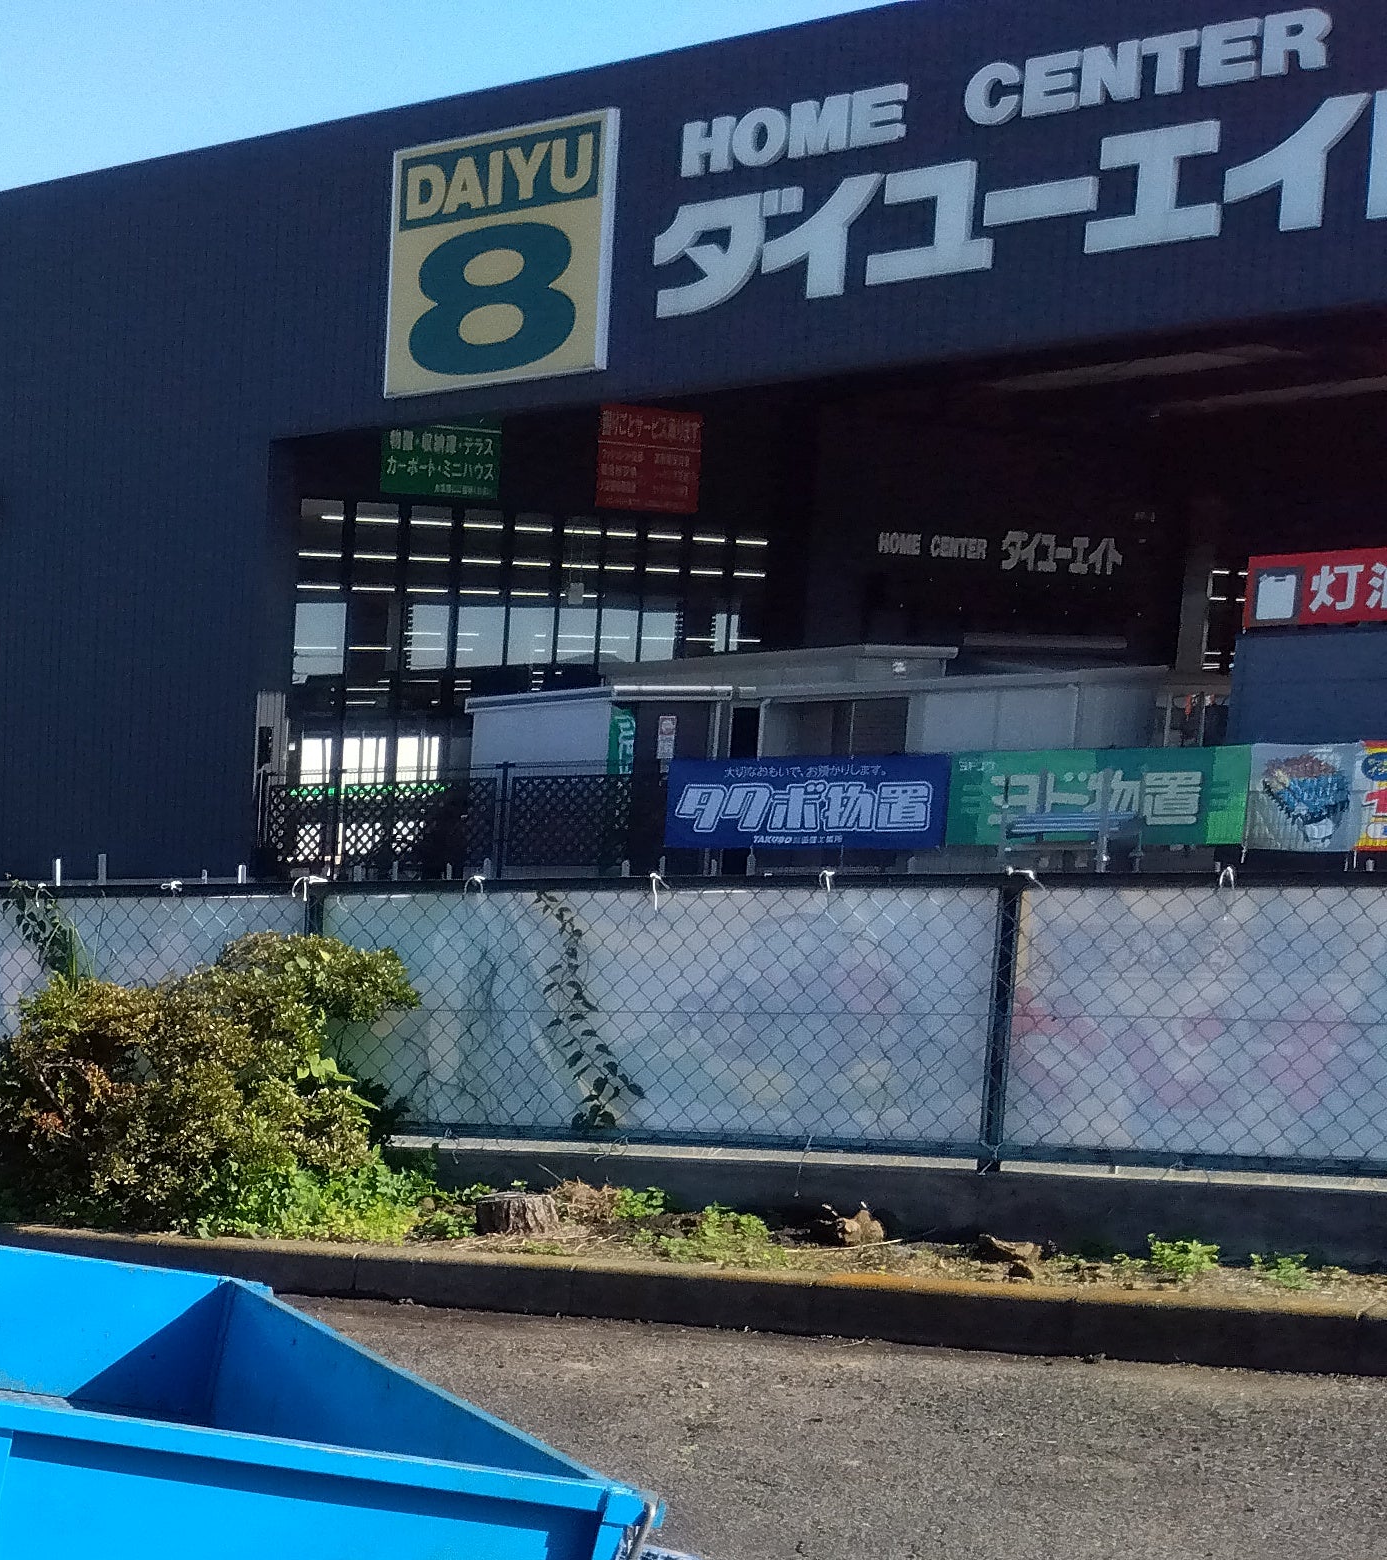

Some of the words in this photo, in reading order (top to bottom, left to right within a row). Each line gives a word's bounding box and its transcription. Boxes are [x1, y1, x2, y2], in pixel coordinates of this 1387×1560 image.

[680, 82, 909, 178] HOME
[964, 8, 1333, 126] CENTER
[406, 133, 594, 221] DAIYU
[408, 221, 577, 376] 8
[878, 532, 922, 555] HOME
[930, 535, 988, 560] CENTER
[1002, 531, 1123, 575] ダイユーエイト
[675, 780, 932, 832] タクボ物置
